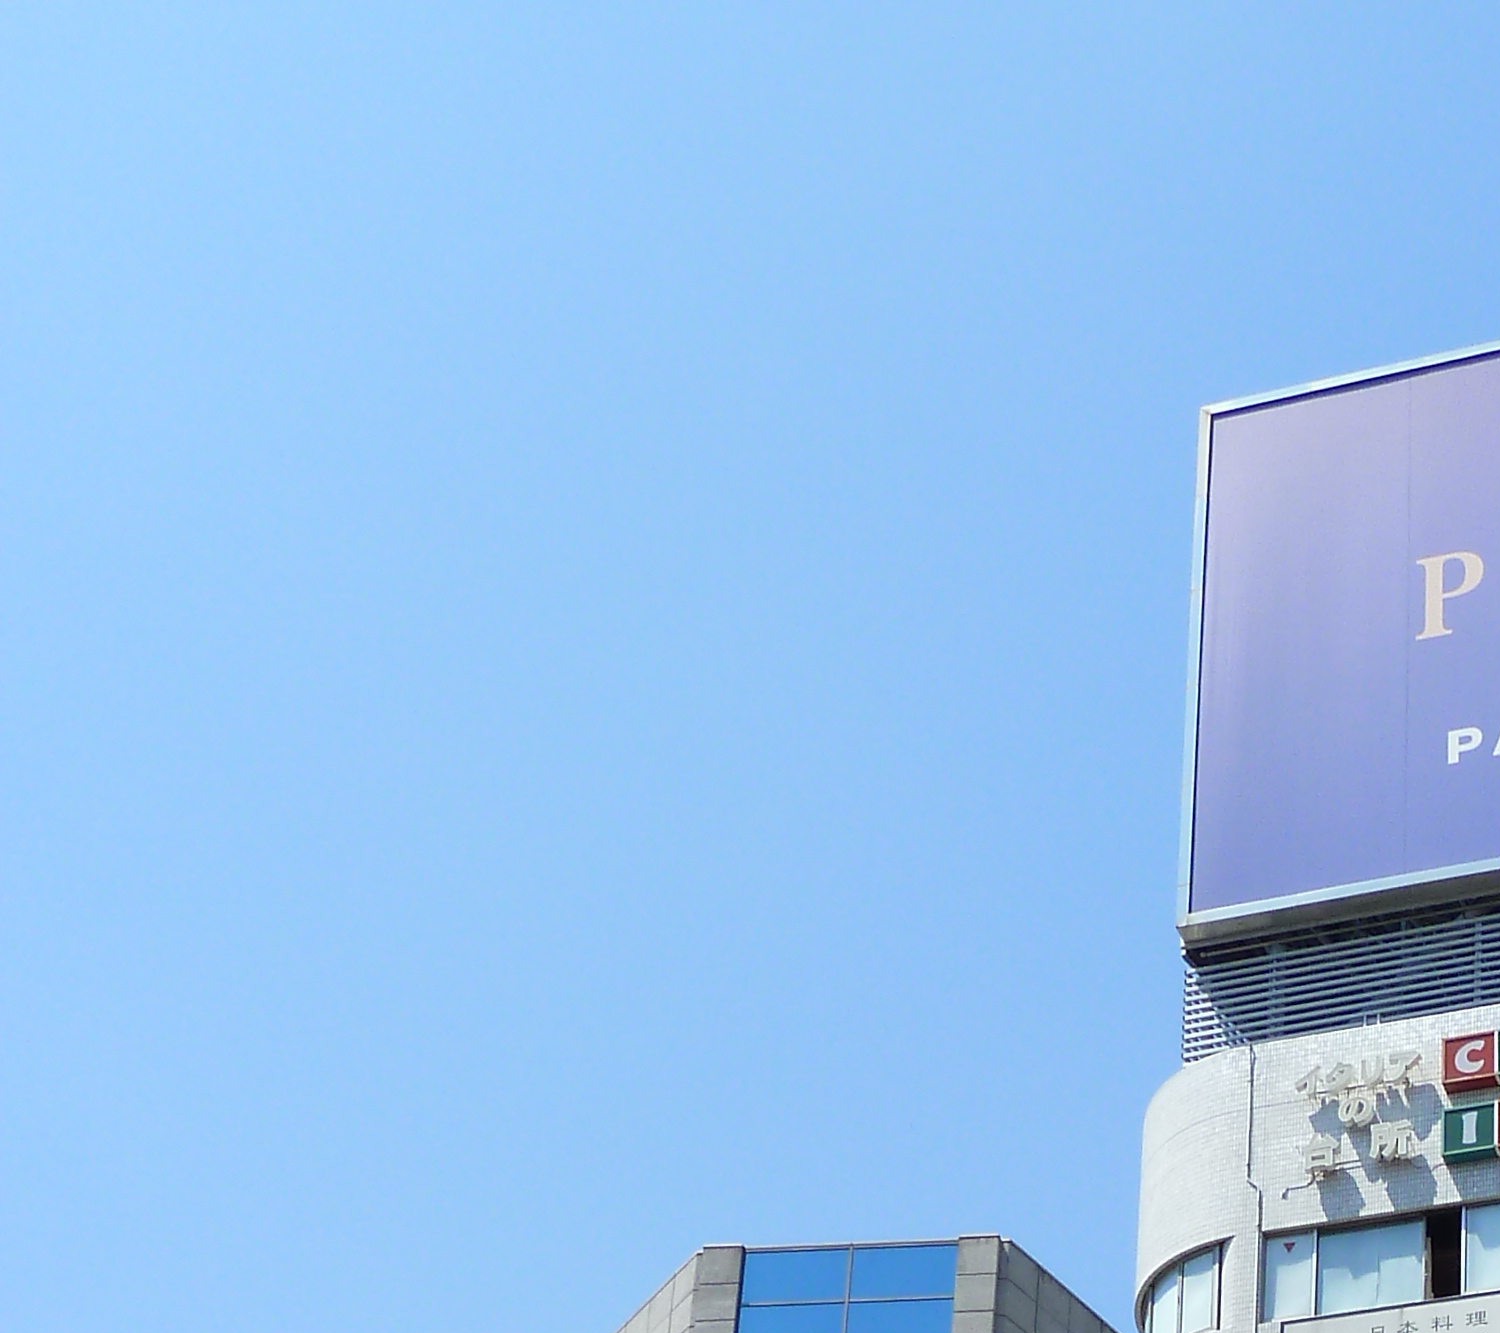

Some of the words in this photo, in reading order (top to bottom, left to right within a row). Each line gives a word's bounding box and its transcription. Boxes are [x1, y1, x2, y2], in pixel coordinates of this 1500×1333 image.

[1295, 1050, 1423, 1095] イタリア
[1338, 1091, 1374, 1128] の
[1302, 1119, 1414, 1175] 台所
